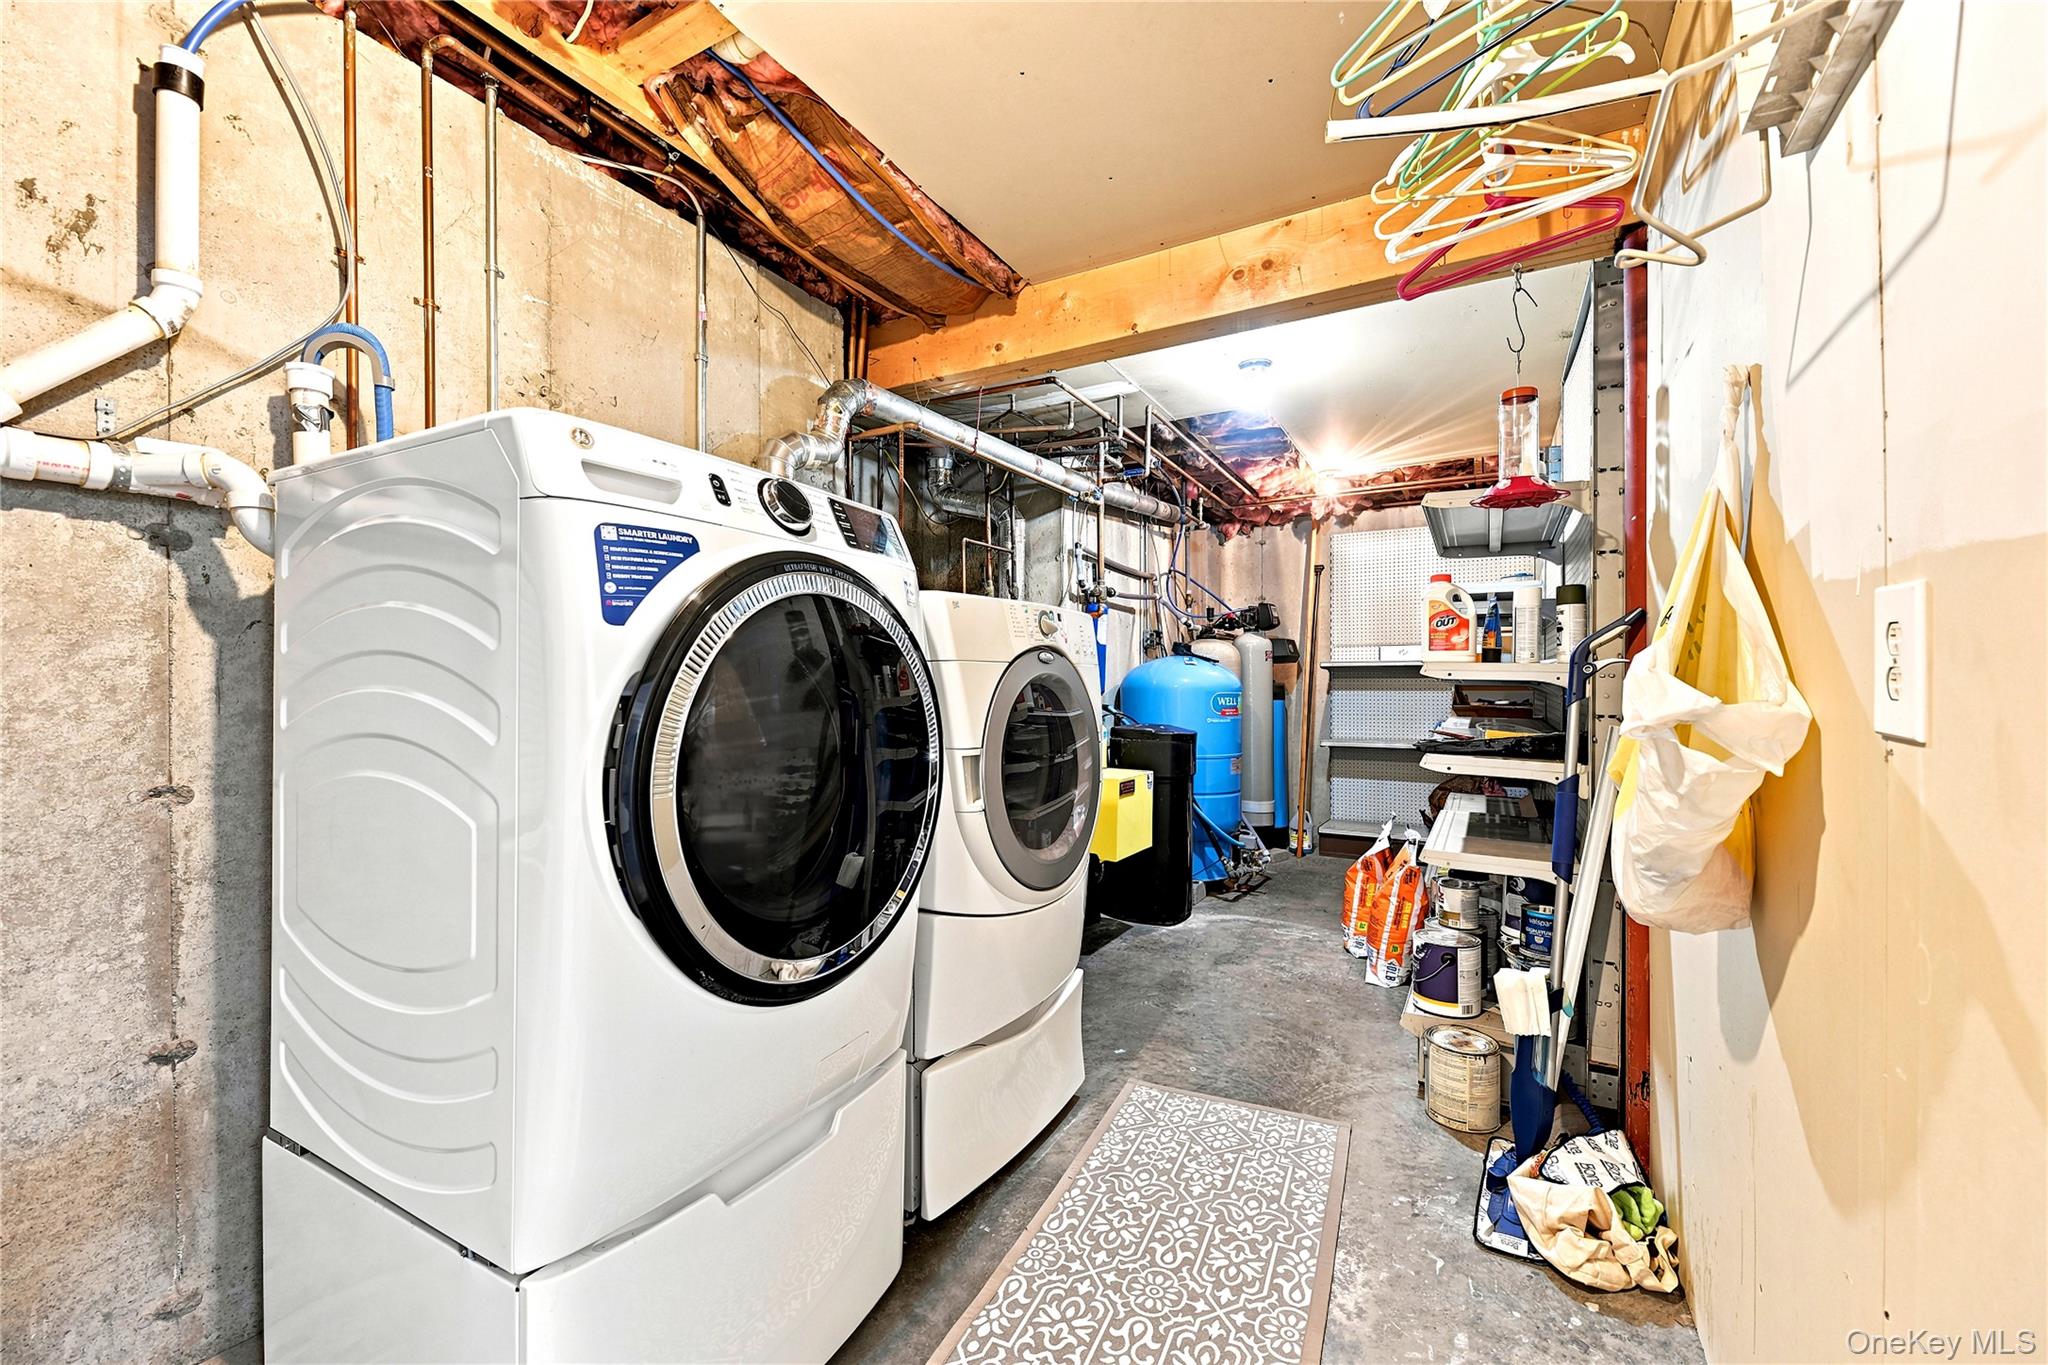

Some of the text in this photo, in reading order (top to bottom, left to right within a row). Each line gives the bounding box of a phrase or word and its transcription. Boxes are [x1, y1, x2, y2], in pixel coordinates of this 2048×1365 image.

[618, 527, 657, 539] SMARTER
[658, 533, 693, 544] LAUNDRY
[1435, 616, 1457, 628] OUT
[1217, 696, 1237, 706] WELL
